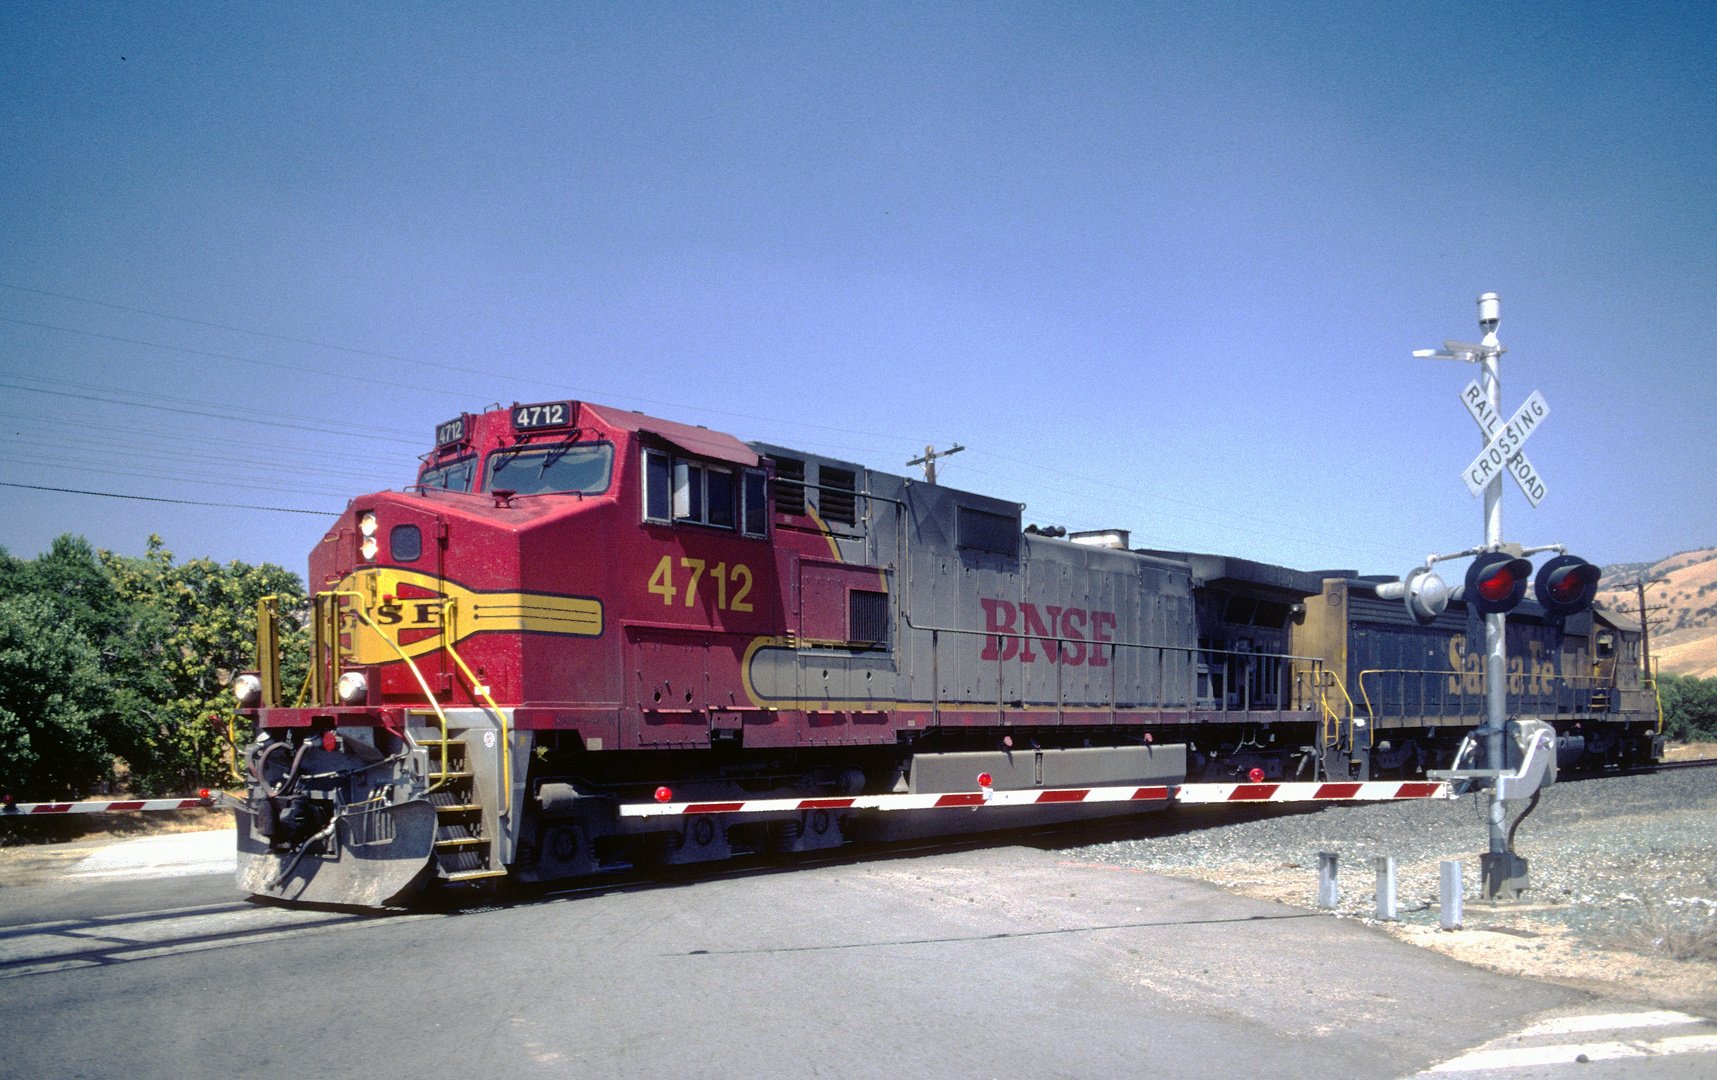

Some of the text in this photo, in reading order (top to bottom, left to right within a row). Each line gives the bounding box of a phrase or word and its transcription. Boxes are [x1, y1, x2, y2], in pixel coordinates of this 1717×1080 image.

[438, 420, 463, 443] 4712
[517, 404, 563, 426] 4712
[1466, 385, 1545, 500] RAIL ROAD
[1471, 401, 1544, 486] CROSSING
[648, 555, 754, 612] 4712
[980, 598, 1117, 667] BNSF
[1528, 640, 1555, 696] Fe
